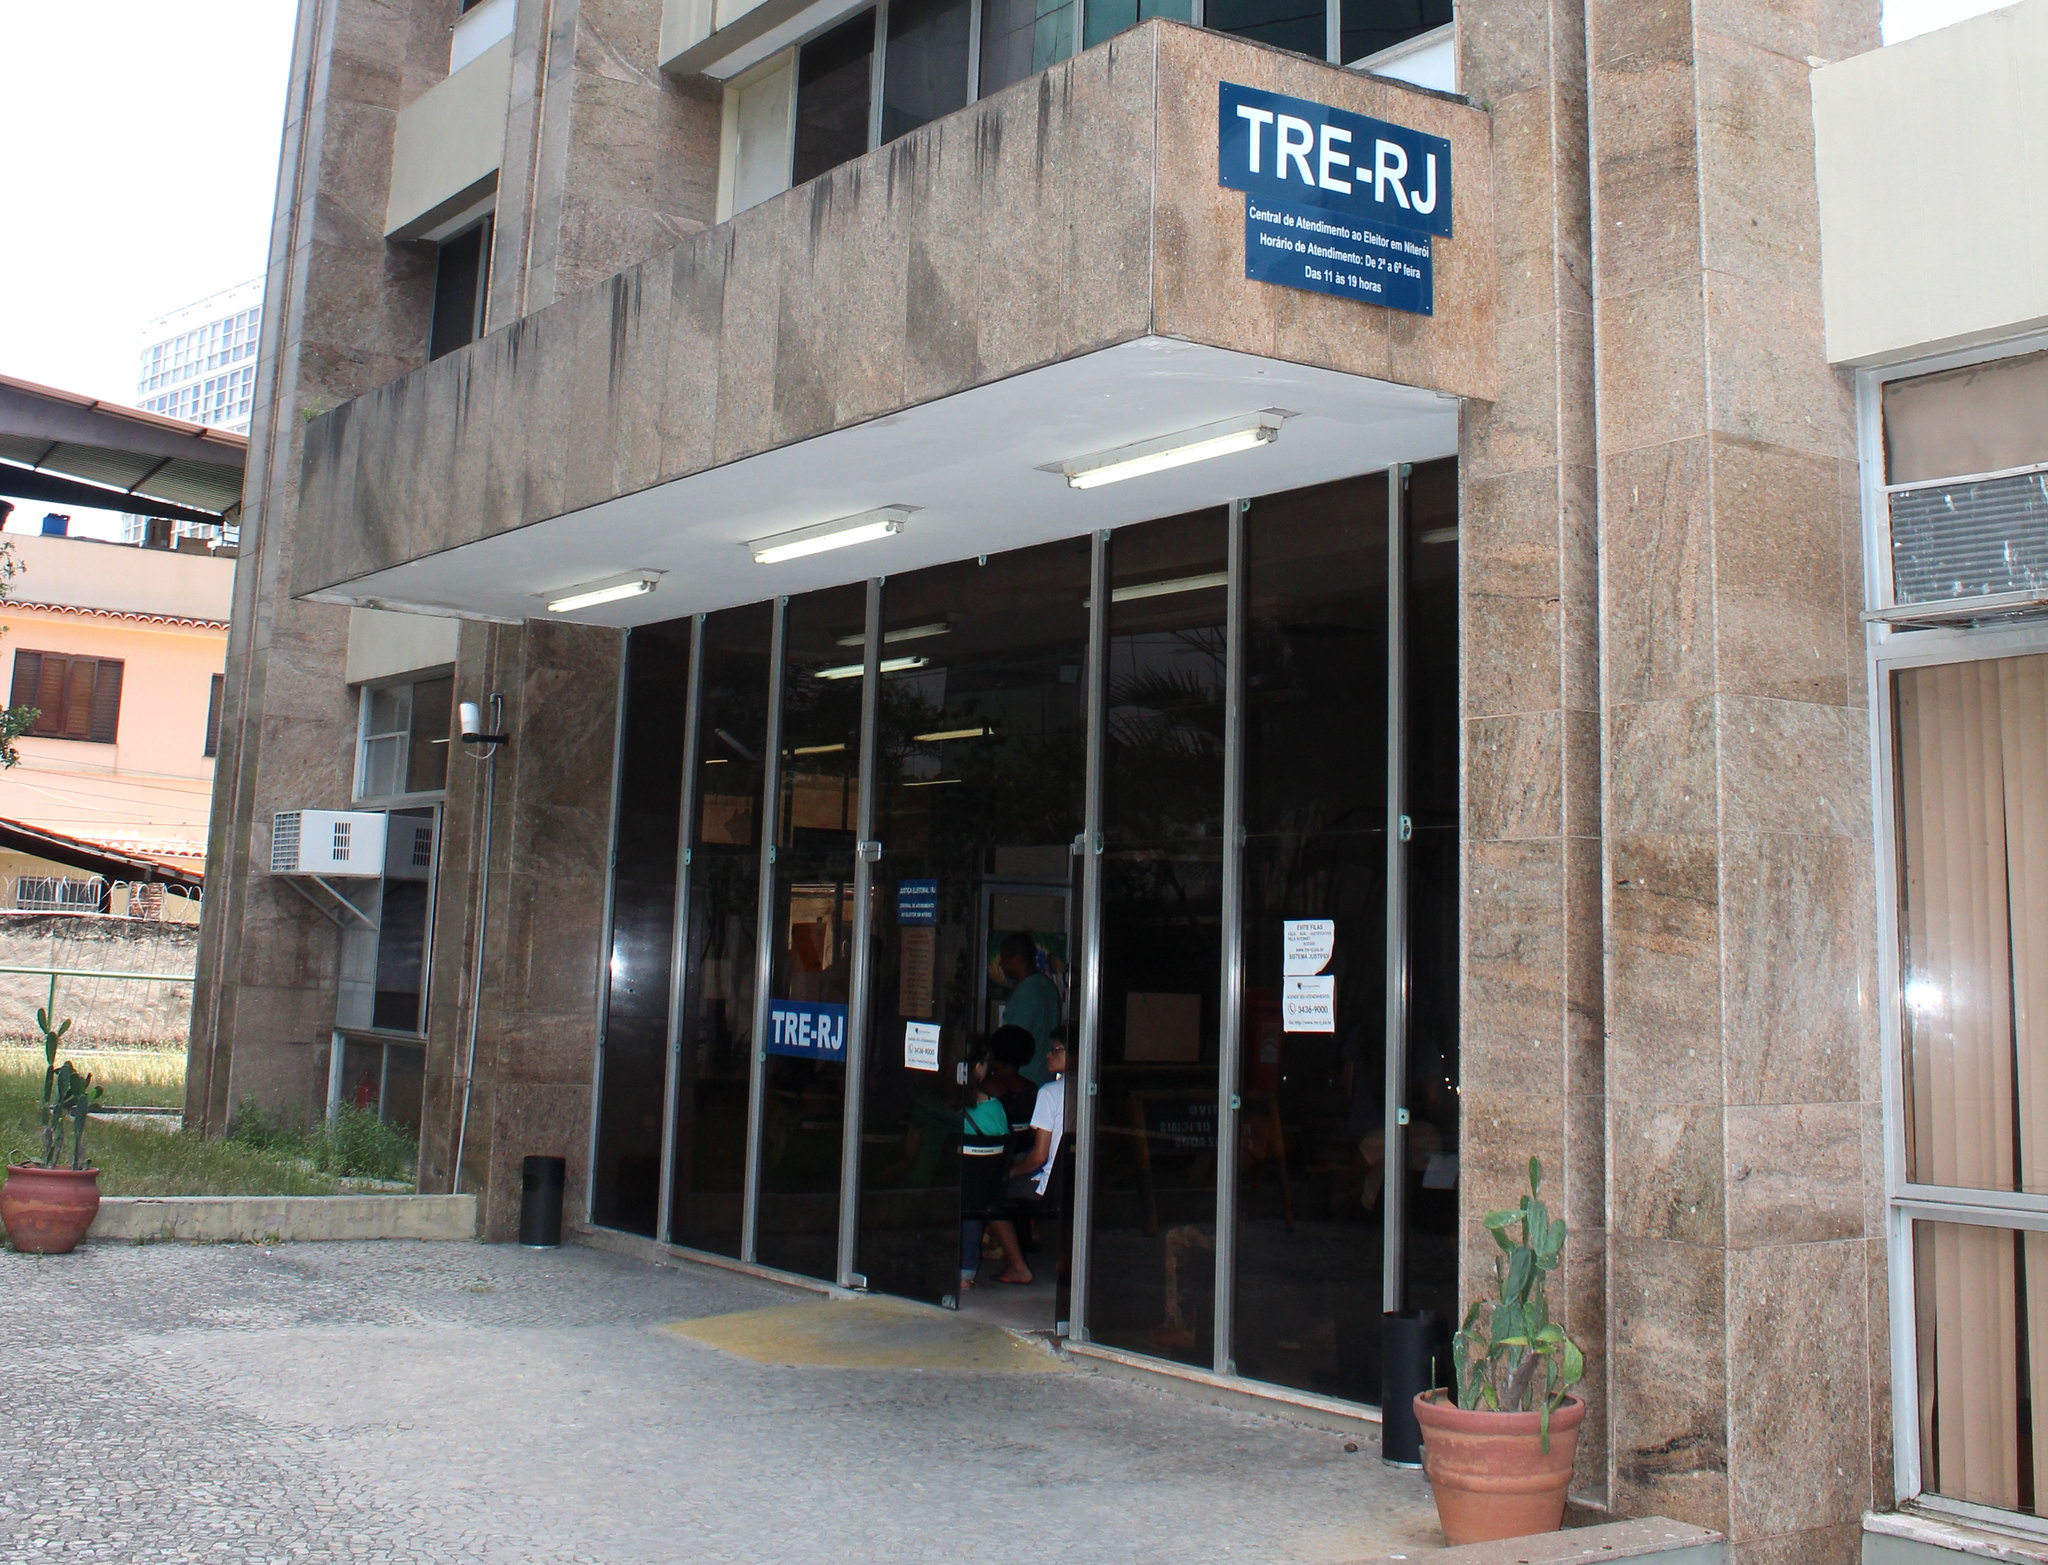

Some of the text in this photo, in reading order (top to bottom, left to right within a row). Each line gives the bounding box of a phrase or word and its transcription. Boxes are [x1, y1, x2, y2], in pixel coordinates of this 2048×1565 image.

[1236, 104, 1437, 215] TRE-RJ
[1249, 206, 1430, 258] Central de Atendimento ao Eleitor em Niterói
[1260, 232, 1293, 251] Horário
[1294, 240, 1306, 254] de
[1307, 242, 1364, 266] Atendimento:
[1365, 254, 1376, 269] De
[1387, 262, 1393, 272] a
[1403, 264, 1421, 279] feira
[1305, 265, 1382, 293] Das 11 às 19 horas
[771, 1010, 844, 1050] TRE-RJ
[1298, 1005, 1328, 1014] 3436-9000
